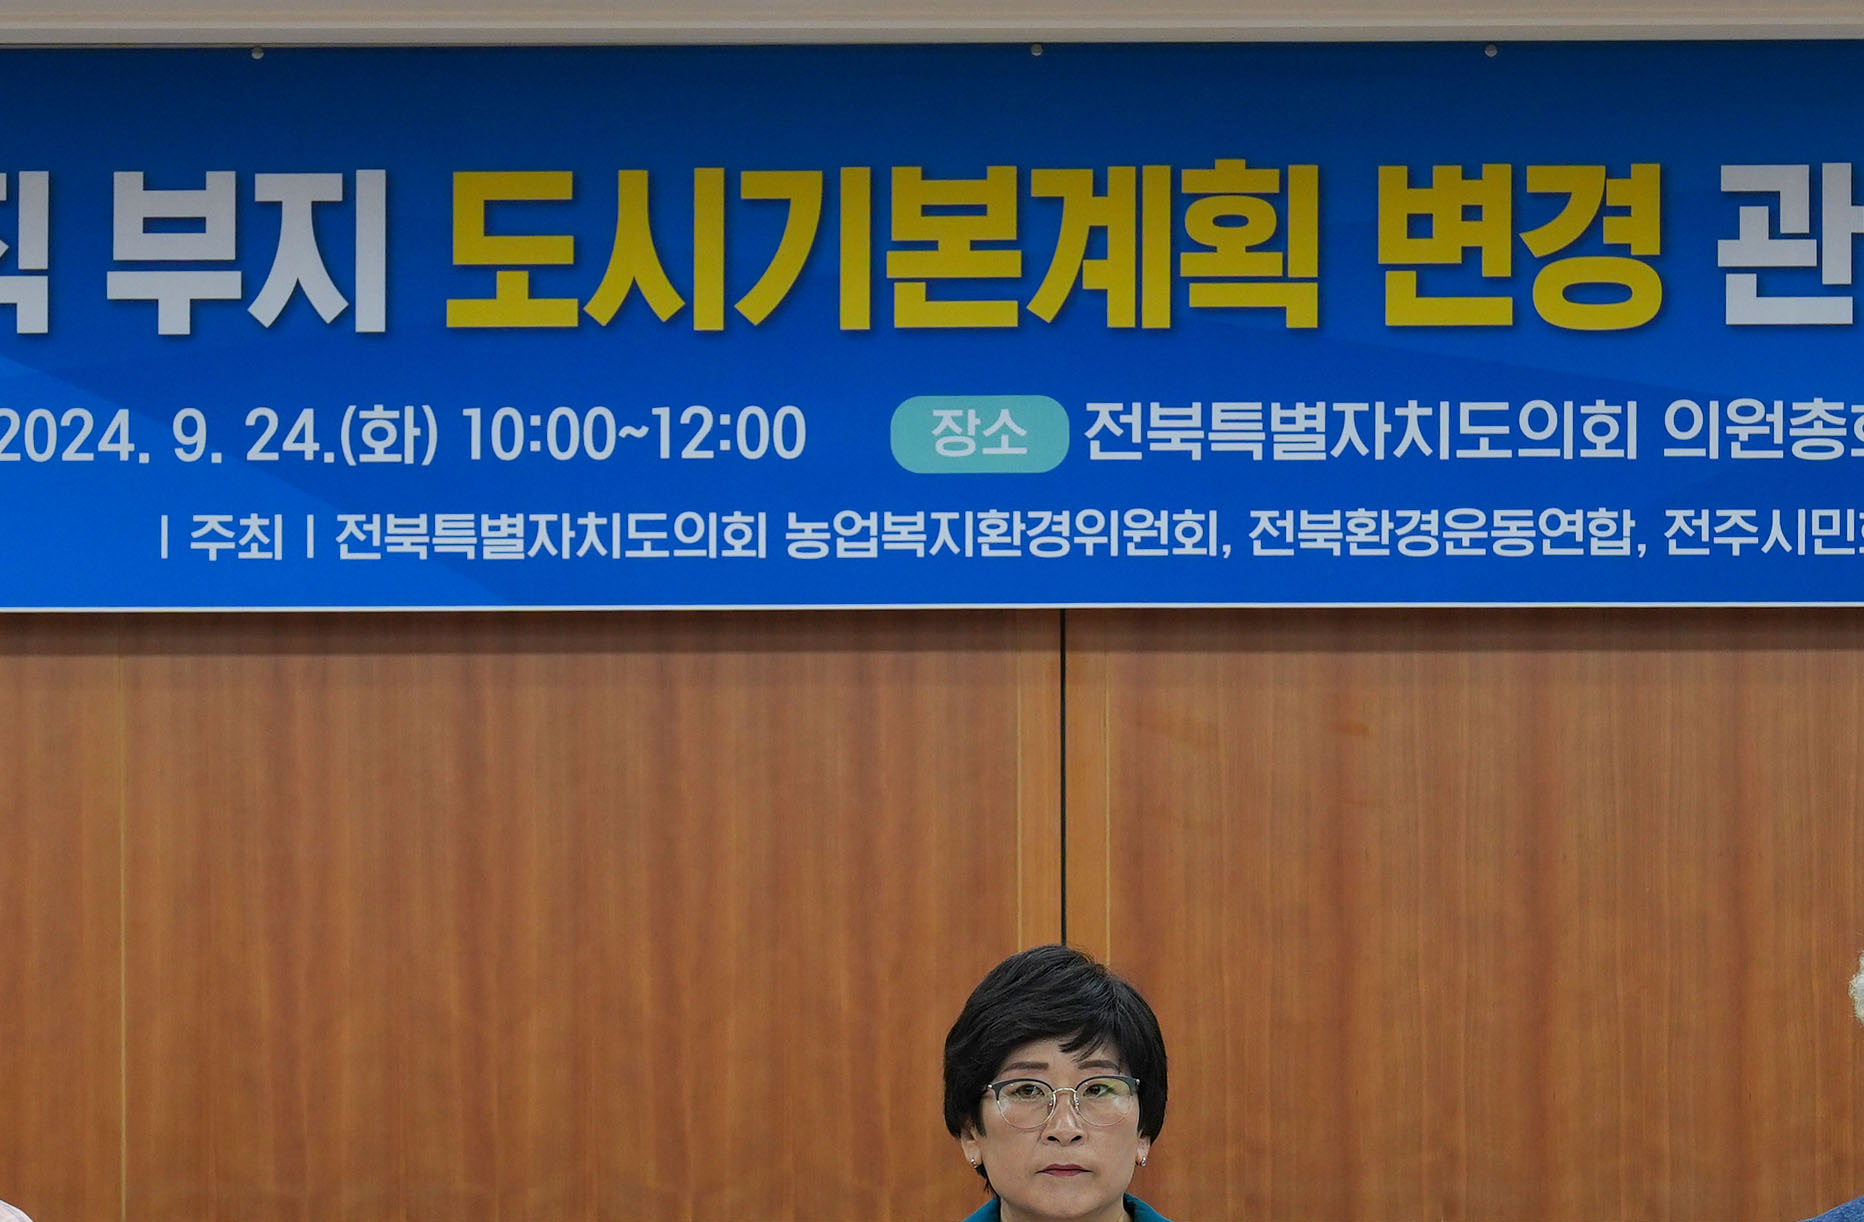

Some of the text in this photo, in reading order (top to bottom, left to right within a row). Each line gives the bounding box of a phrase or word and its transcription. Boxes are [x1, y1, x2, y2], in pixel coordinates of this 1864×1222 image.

[107, 170, 385, 334] 부지
[447, 160, 1318, 330] 도시기본계획
[1378, 164, 1662, 330] 변경
[174, 409, 221, 462] 9.
[246, 405, 436, 465] 24.(화)
[463, 406, 805, 460] 10:00~12:00
[932, 409, 1027, 457] 장소
[1086, 400, 1636, 460] 전북특별자치도의회
[191, 514, 282, 560] 주최
[336, 511, 766, 560] 전북특별자치도의회
[786, 509, 1231, 559] 농업복지환경위원회,
[1249, 508, 1646, 557] 전북환경운동연합,
